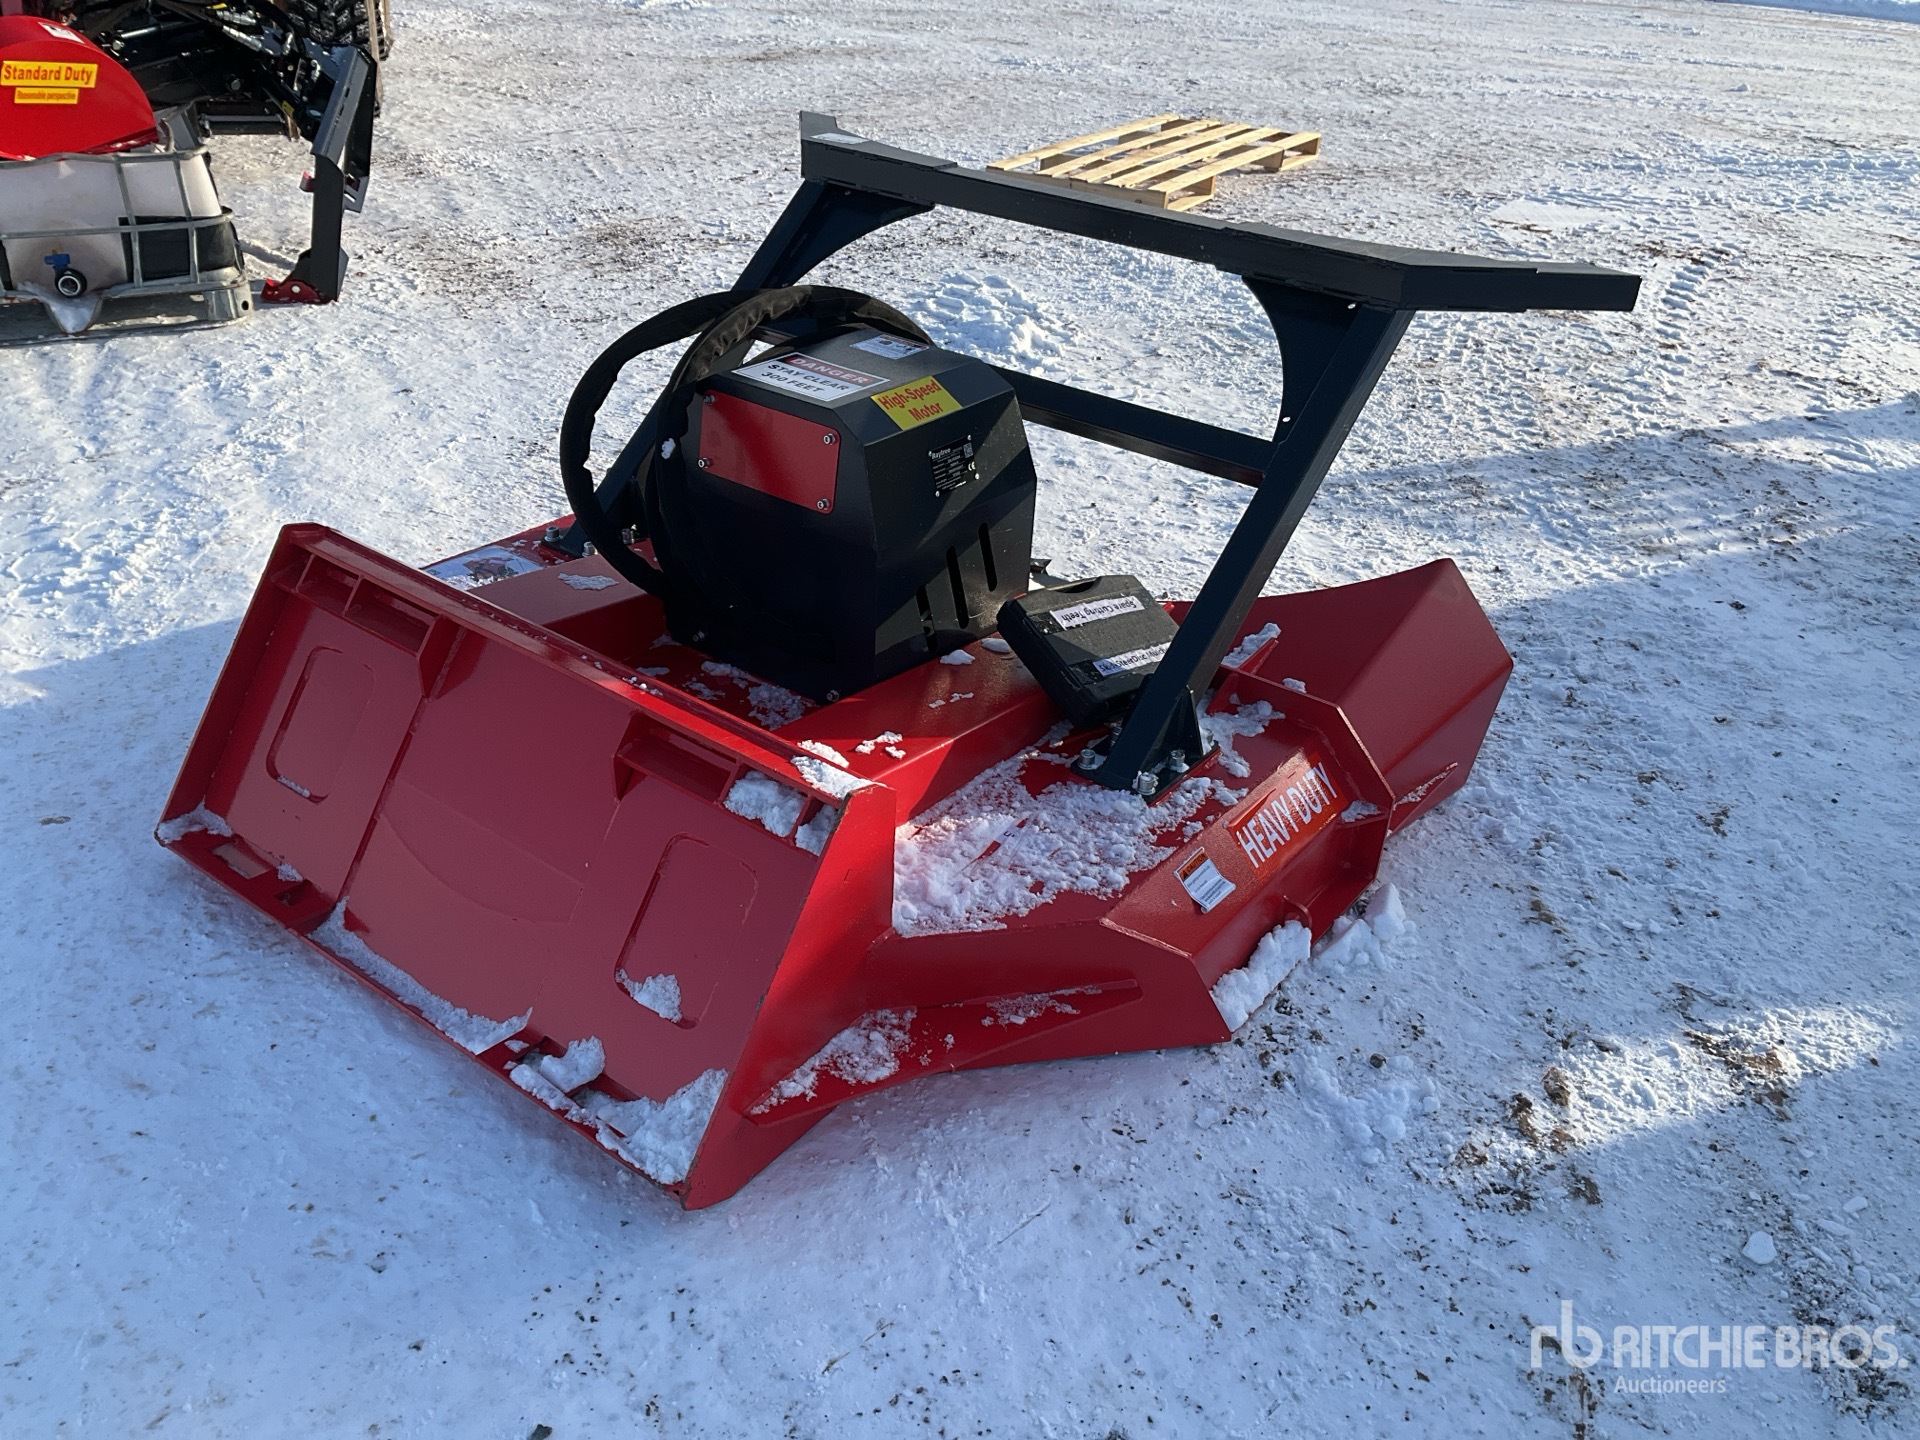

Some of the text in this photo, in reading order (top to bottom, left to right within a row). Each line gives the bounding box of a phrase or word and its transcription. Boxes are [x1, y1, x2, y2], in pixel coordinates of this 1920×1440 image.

[4, 64, 92, 85] Standard Duty
[761, 372, 825, 393] 300 FEET
[768, 364, 849, 391] STAY CLEAR
[792, 357, 868, 384] DANGER
[877, 380, 941, 410] High-Speed
[908, 401, 944, 422] Motor
[1061, 601, 1137, 623] Spare Cutting Teeth
[1236, 762, 1337, 869] HEAVY DUTY
